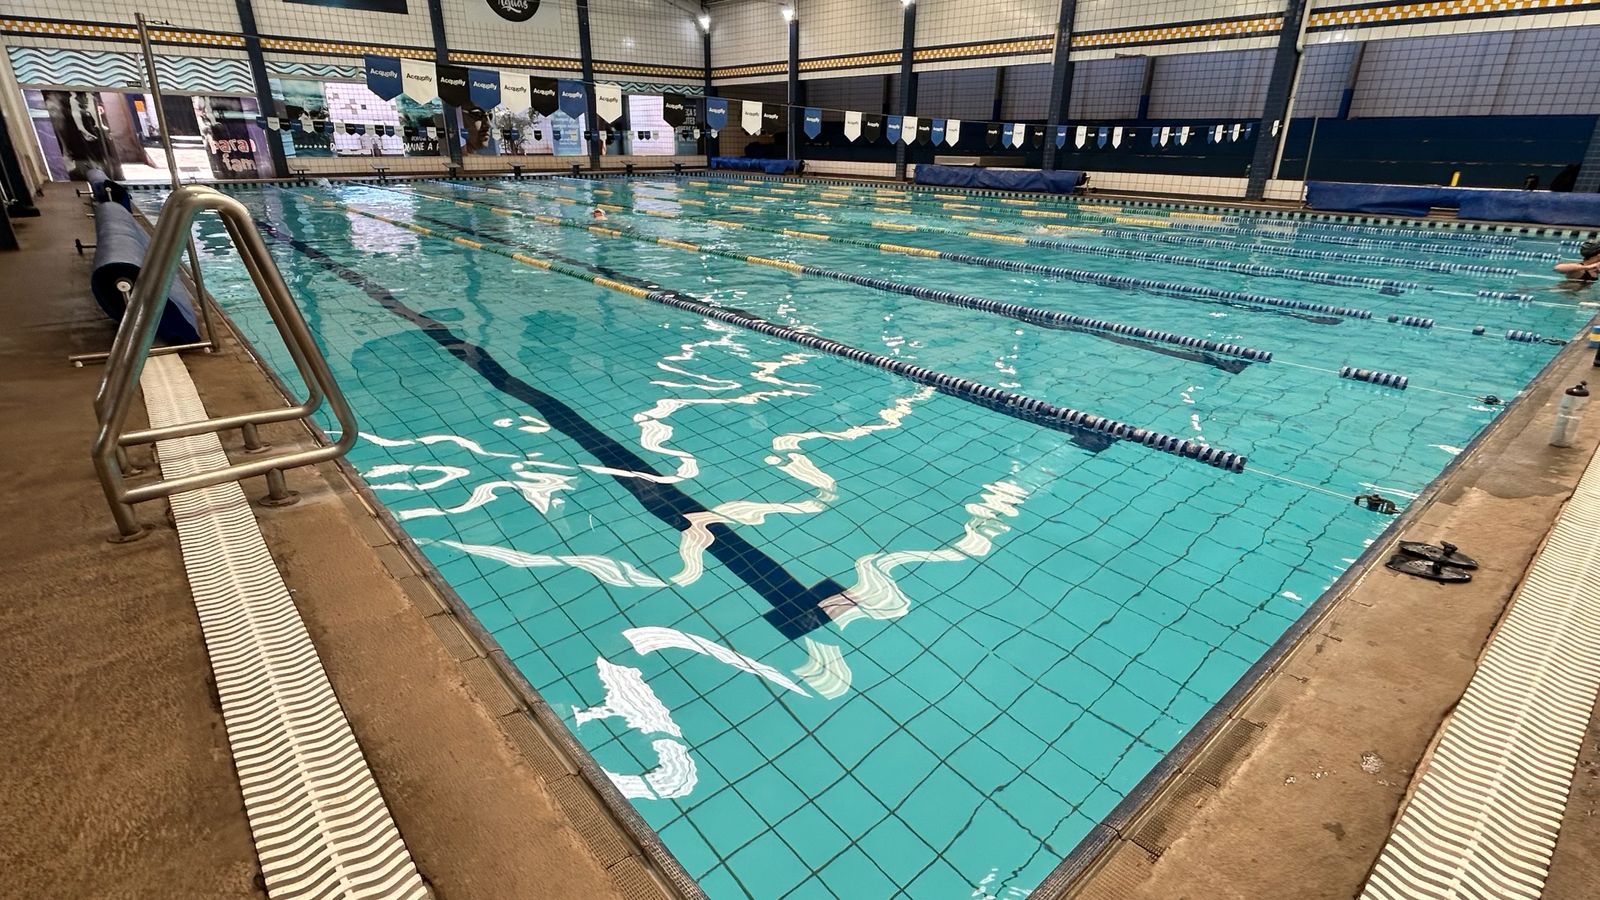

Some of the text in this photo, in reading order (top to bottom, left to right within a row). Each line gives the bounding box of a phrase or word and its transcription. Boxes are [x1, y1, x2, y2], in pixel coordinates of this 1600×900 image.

[370, 68, 398, 78] Acquafly
[406, 73, 433, 82] Acquafly
[440, 76, 466, 87] Acquafly
